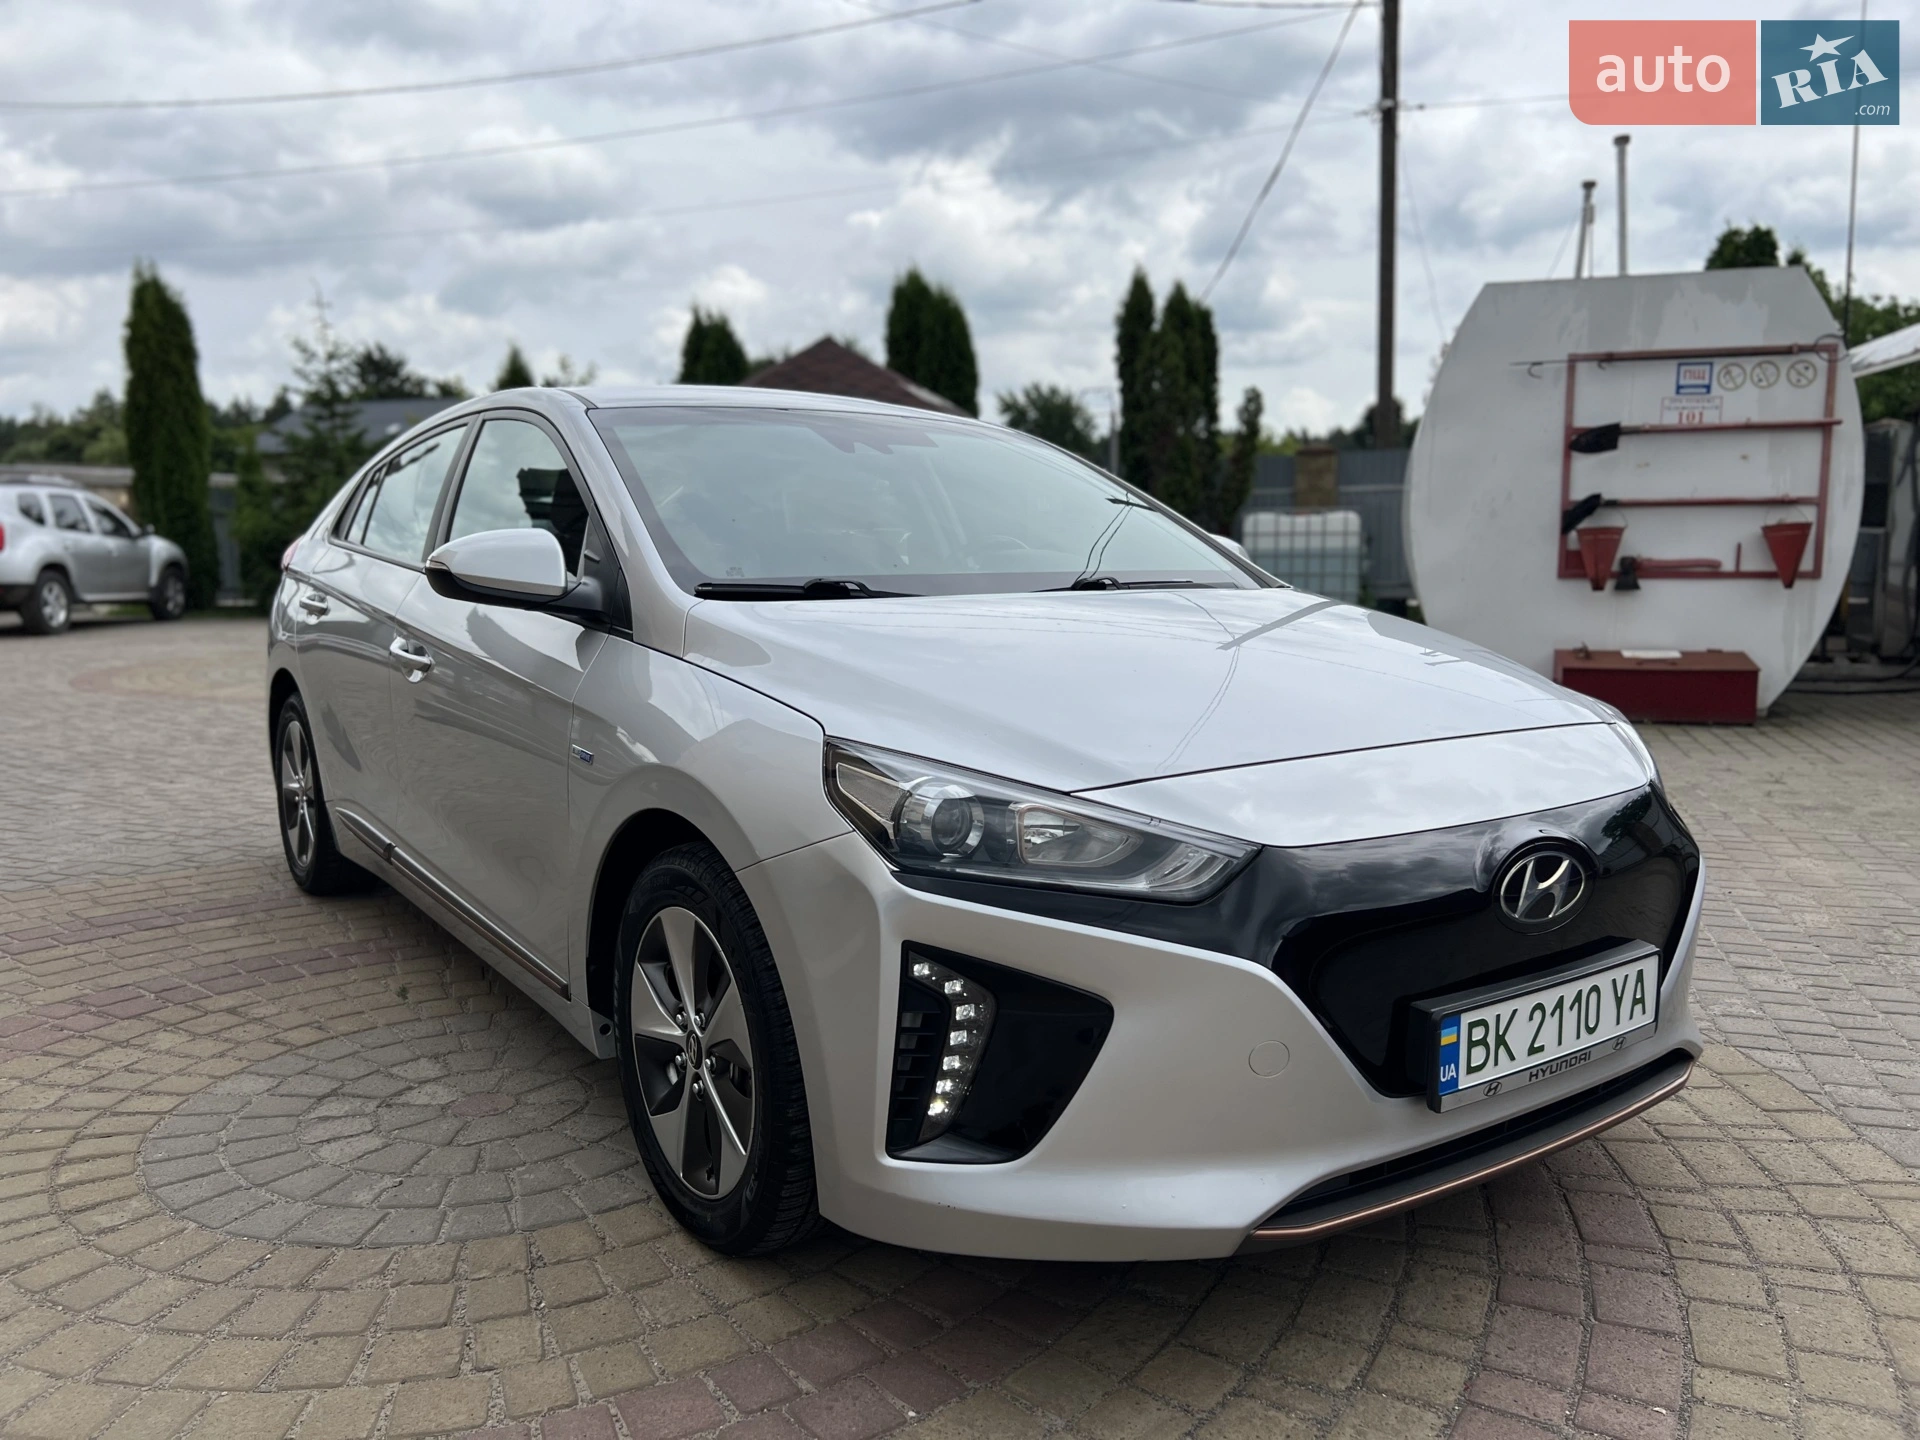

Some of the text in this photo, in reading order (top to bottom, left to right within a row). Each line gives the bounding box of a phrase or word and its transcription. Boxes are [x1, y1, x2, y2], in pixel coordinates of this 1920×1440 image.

[1678, 412, 1704, 425] 101
[1466, 968, 1647, 1076] BK 2110 YA
[1440, 1063, 1457, 1083] UA
[1528, 1051, 1592, 1082] HYUNDAI
